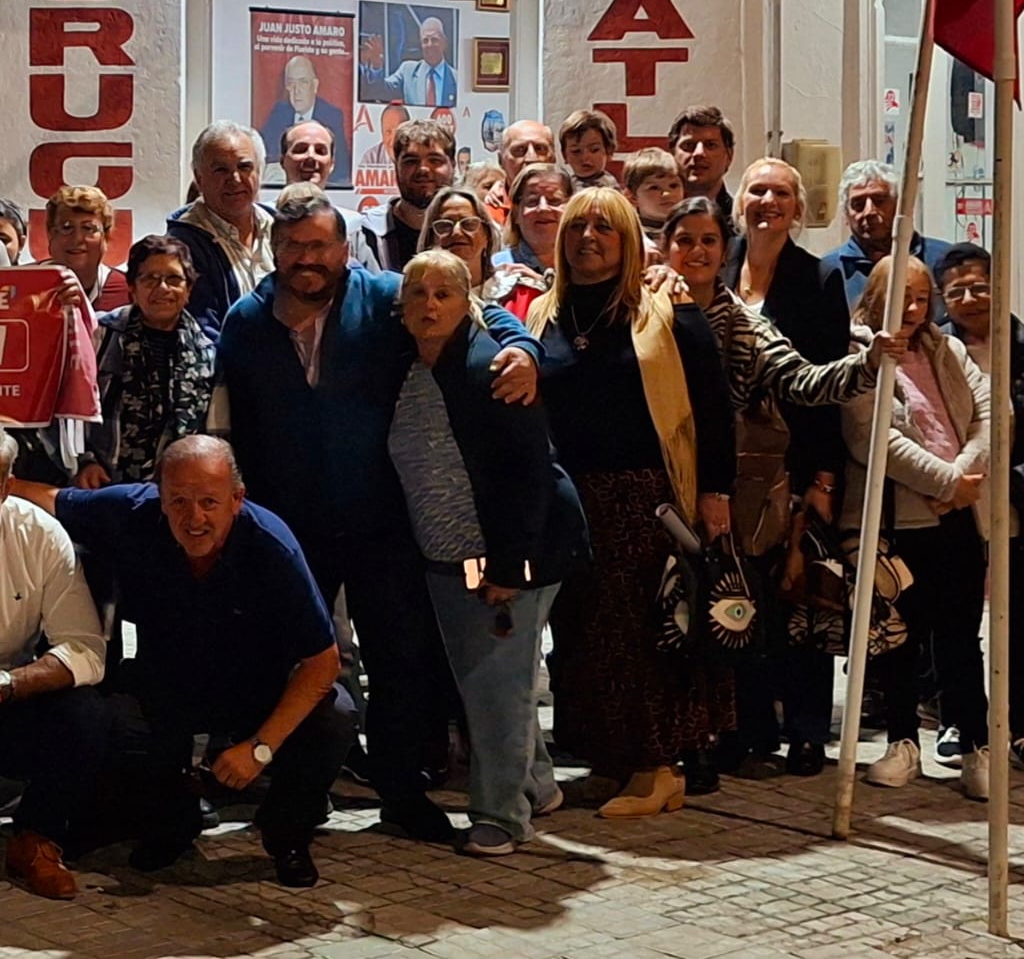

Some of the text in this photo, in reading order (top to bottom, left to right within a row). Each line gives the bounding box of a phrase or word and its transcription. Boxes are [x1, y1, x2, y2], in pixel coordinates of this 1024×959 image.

[259, 22, 345, 37] JUAN JUSTO AMARO
[355, 169, 396, 187] AMA
